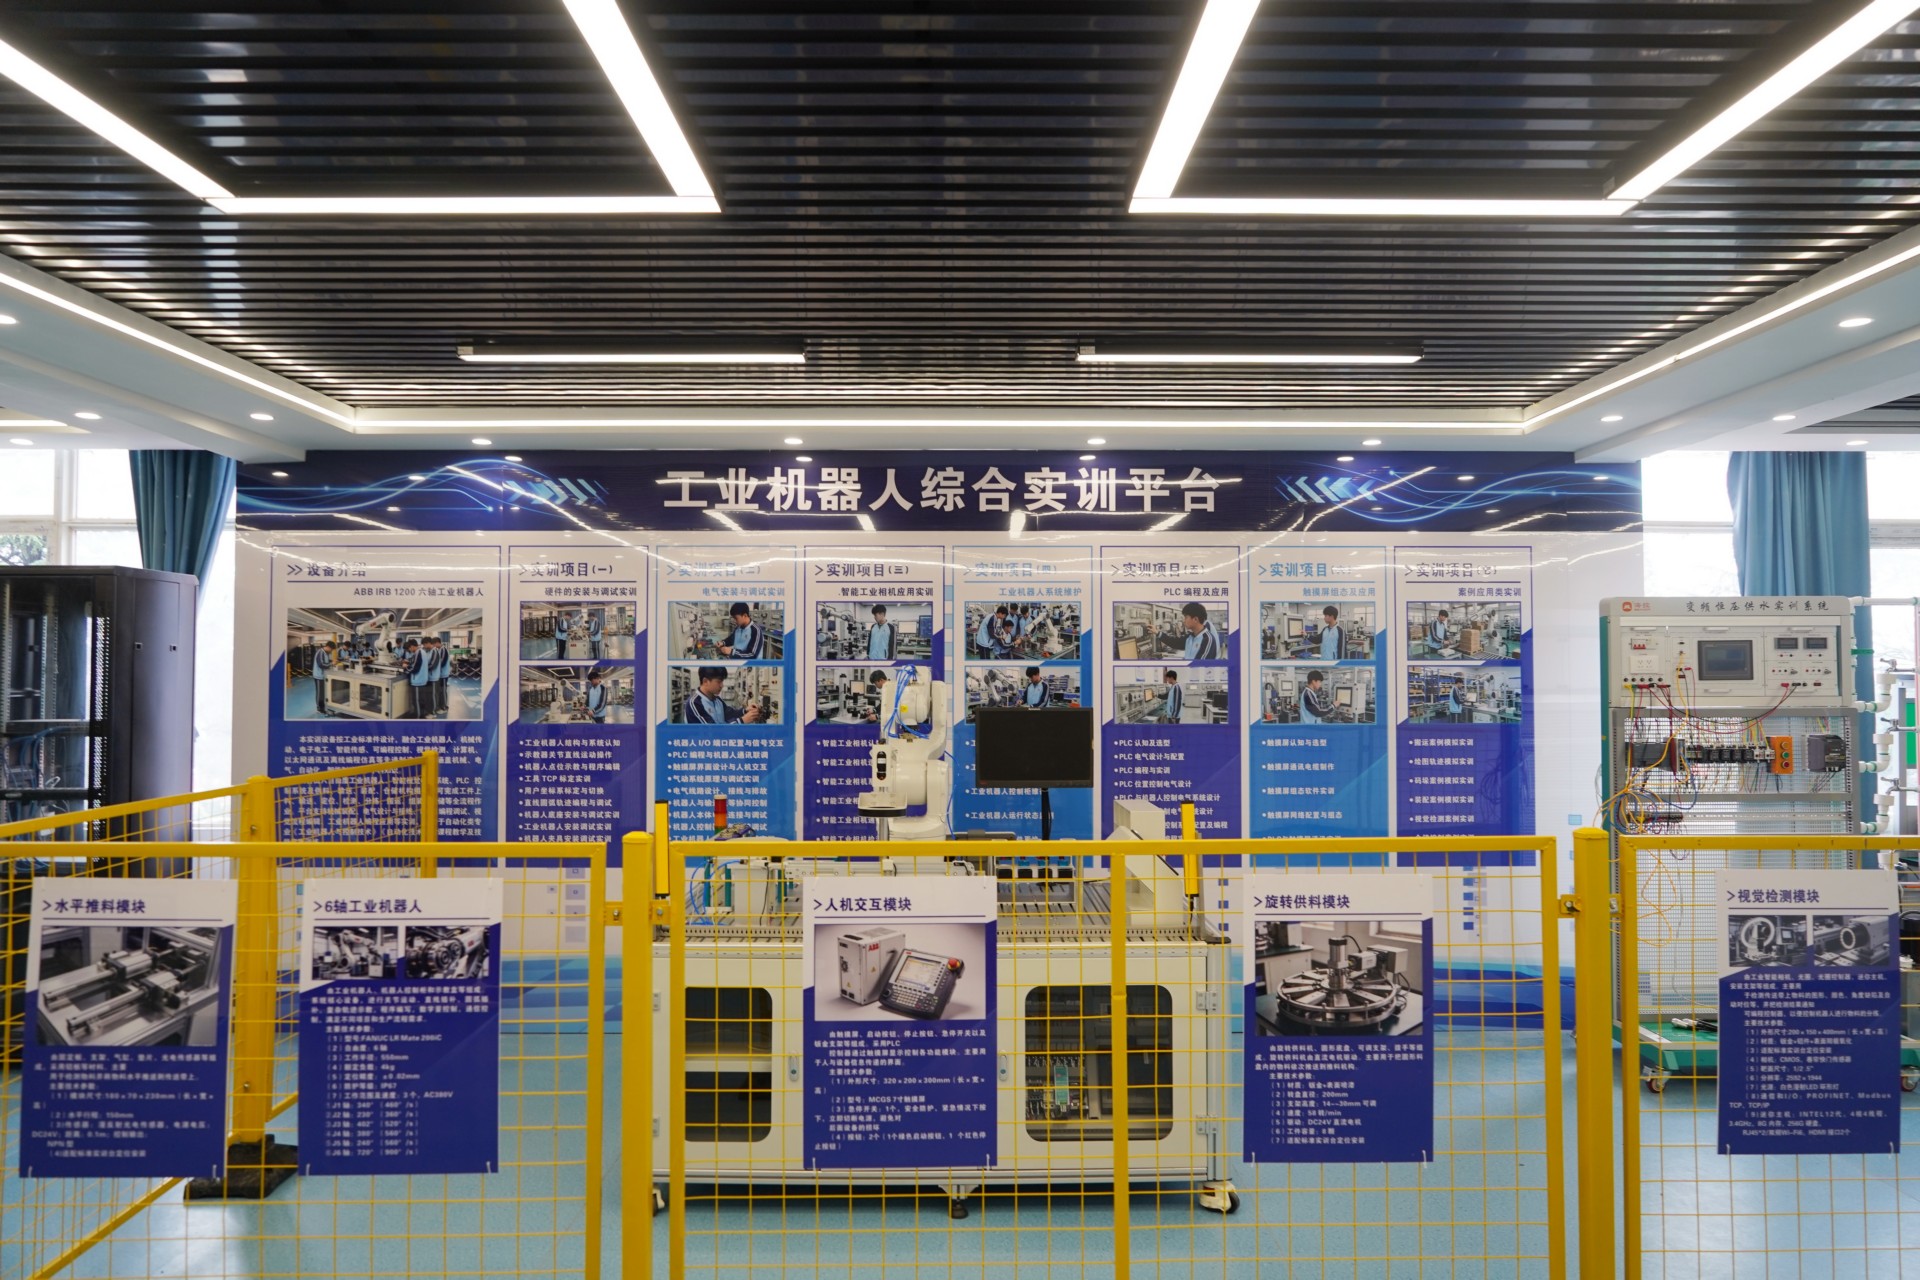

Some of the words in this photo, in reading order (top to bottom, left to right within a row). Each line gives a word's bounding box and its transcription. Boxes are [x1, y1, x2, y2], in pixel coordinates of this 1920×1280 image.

[663, 466, 1218, 513] 工业机器人综合实训平台
[827, 562, 909, 577] 实训项目（三）
[354, 588, 374, 596] ABB
[376, 588, 391, 596] IRB
[395, 588, 416, 596] 1200
[418, 587, 484, 597] 六轴工业机器人
[545, 587, 638, 597] 硬件的安装与调试实训
[702, 587, 785, 597] 电气安装与调试实训
[999, 587, 1082, 597] 工业机器人系统维护
[1163, 588, 1181, 596] PLC
[1183, 587, 1229, 597] 编程及应用
[1303, 587, 1376, 597] 触摸屏组态及应用
[1458, 587, 1522, 597] 案例应用类实训
[1737, 888, 1820, 903] 视觉检测模块
[55, 899, 146, 914] 水平推料模块
[324, 899, 423, 914] 6轴工业机器人
[825, 897, 913, 912] 人机交互模块
[1265, 895, 1350, 909] 旋转供料模块
[868, 944, 880, 952] ABB
